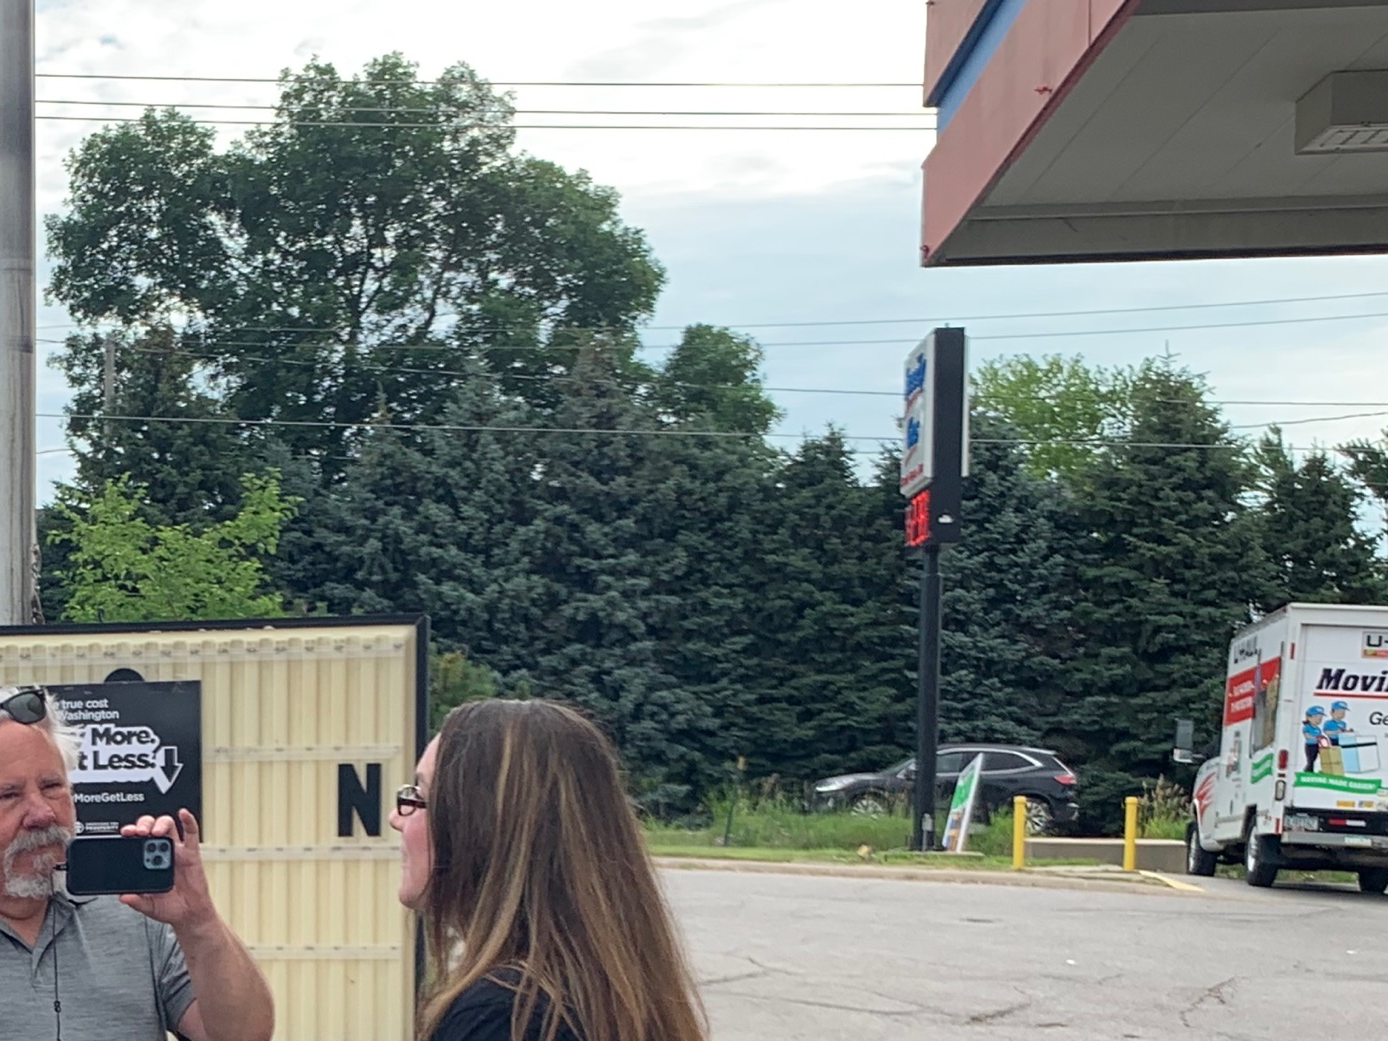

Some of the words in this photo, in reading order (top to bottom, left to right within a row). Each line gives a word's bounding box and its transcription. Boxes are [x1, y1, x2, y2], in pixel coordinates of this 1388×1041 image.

[1315, 667, 1388, 692] Movi
[61, 698, 83, 709] true
[85, 698, 109, 709] cost
[91, 727, 156, 746] More.
[93, 750, 156, 771] Less.
[338, 763, 381, 837] N
